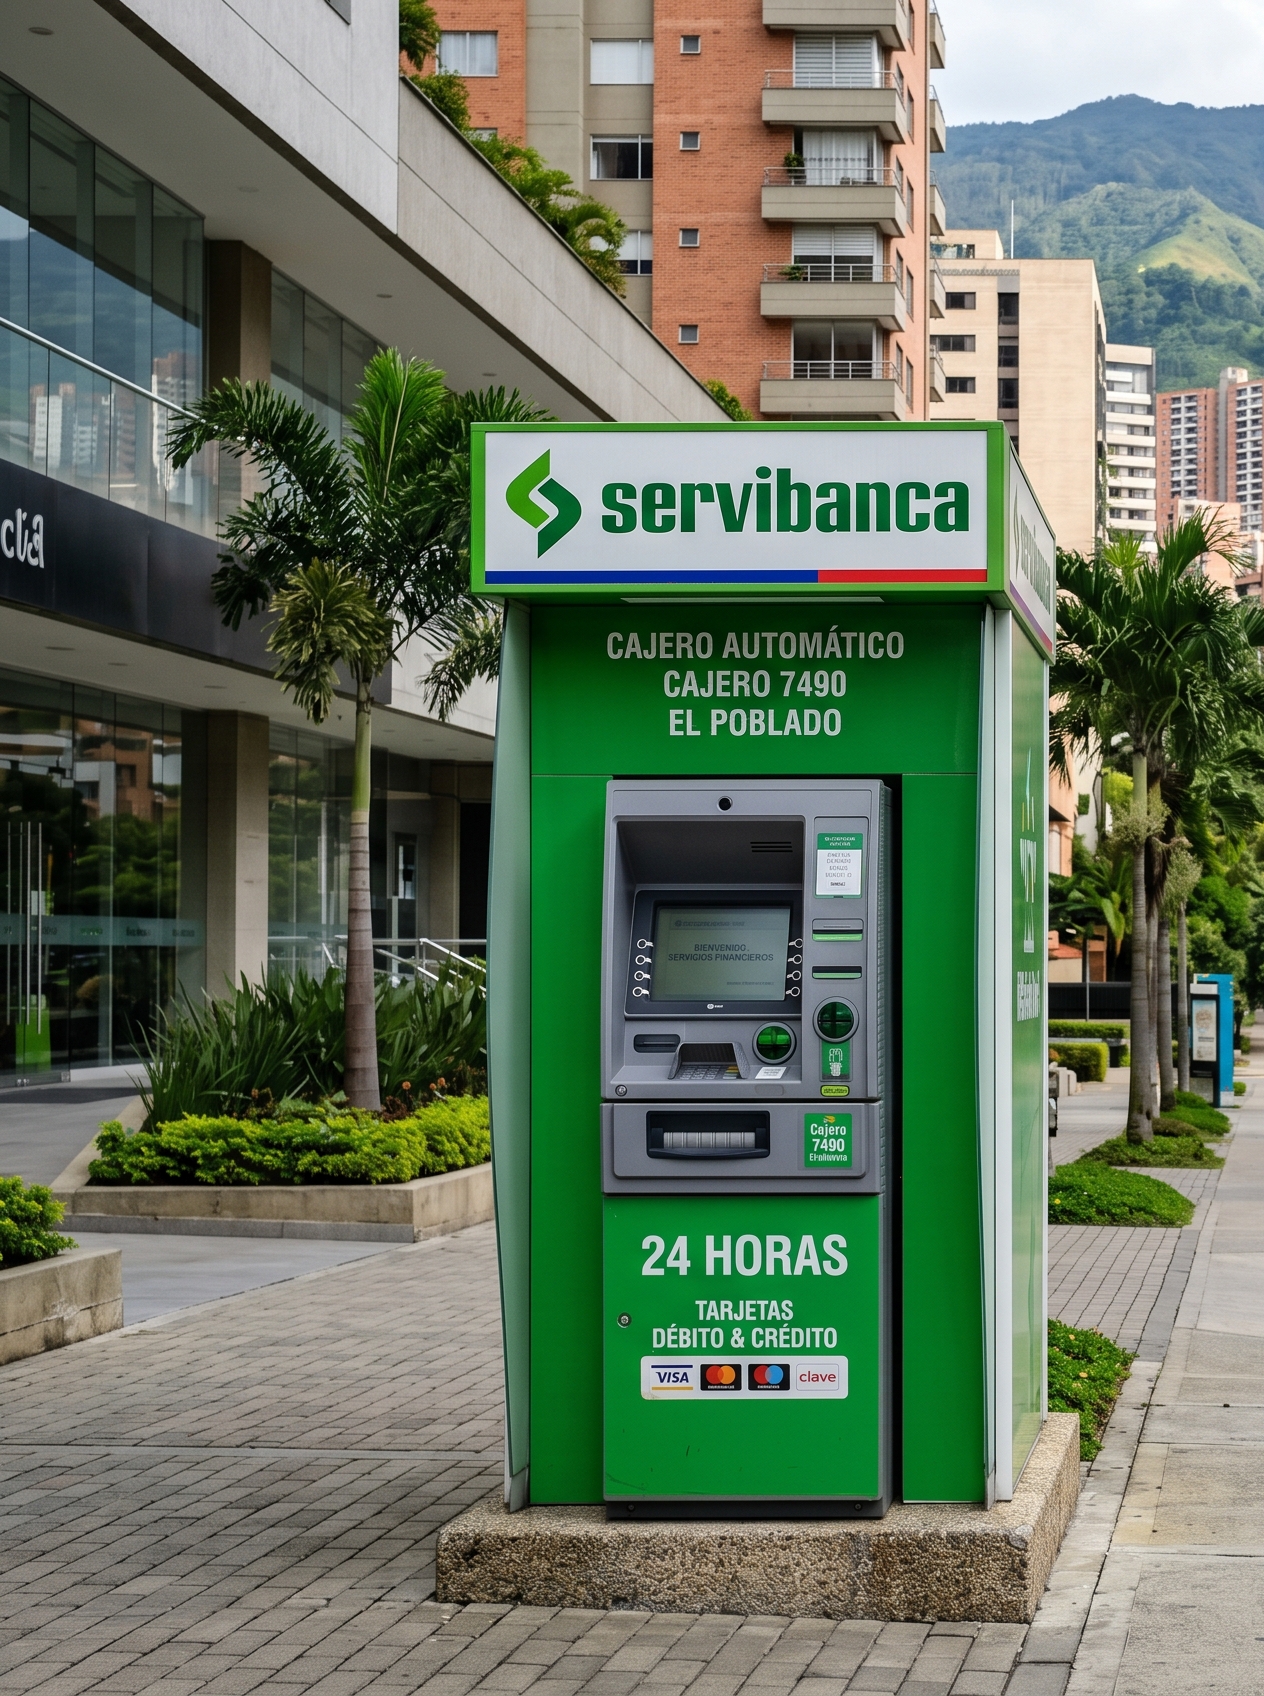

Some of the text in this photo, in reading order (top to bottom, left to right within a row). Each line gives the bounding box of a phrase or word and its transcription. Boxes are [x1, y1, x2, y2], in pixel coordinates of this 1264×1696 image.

[601, 466, 970, 534] servibanca
[607, 625, 904, 659] CAJERO AUTOMÁTICO
[663, 669, 847, 698] CAJERO 7490
[669, 708, 842, 737] EL POBLADO
[810, 1123, 847, 1138] Cajero
[812, 1138, 845, 1152] 7490
[641, 1234, 848, 1277] 24 HORAS
[695, 1299, 794, 1321] TARJETAS
[652, 1323, 838, 1349] DÉBITO & CRÉDITO
[656, 1371, 689, 1384] VISA
[799, 1371, 837, 1382] clave
